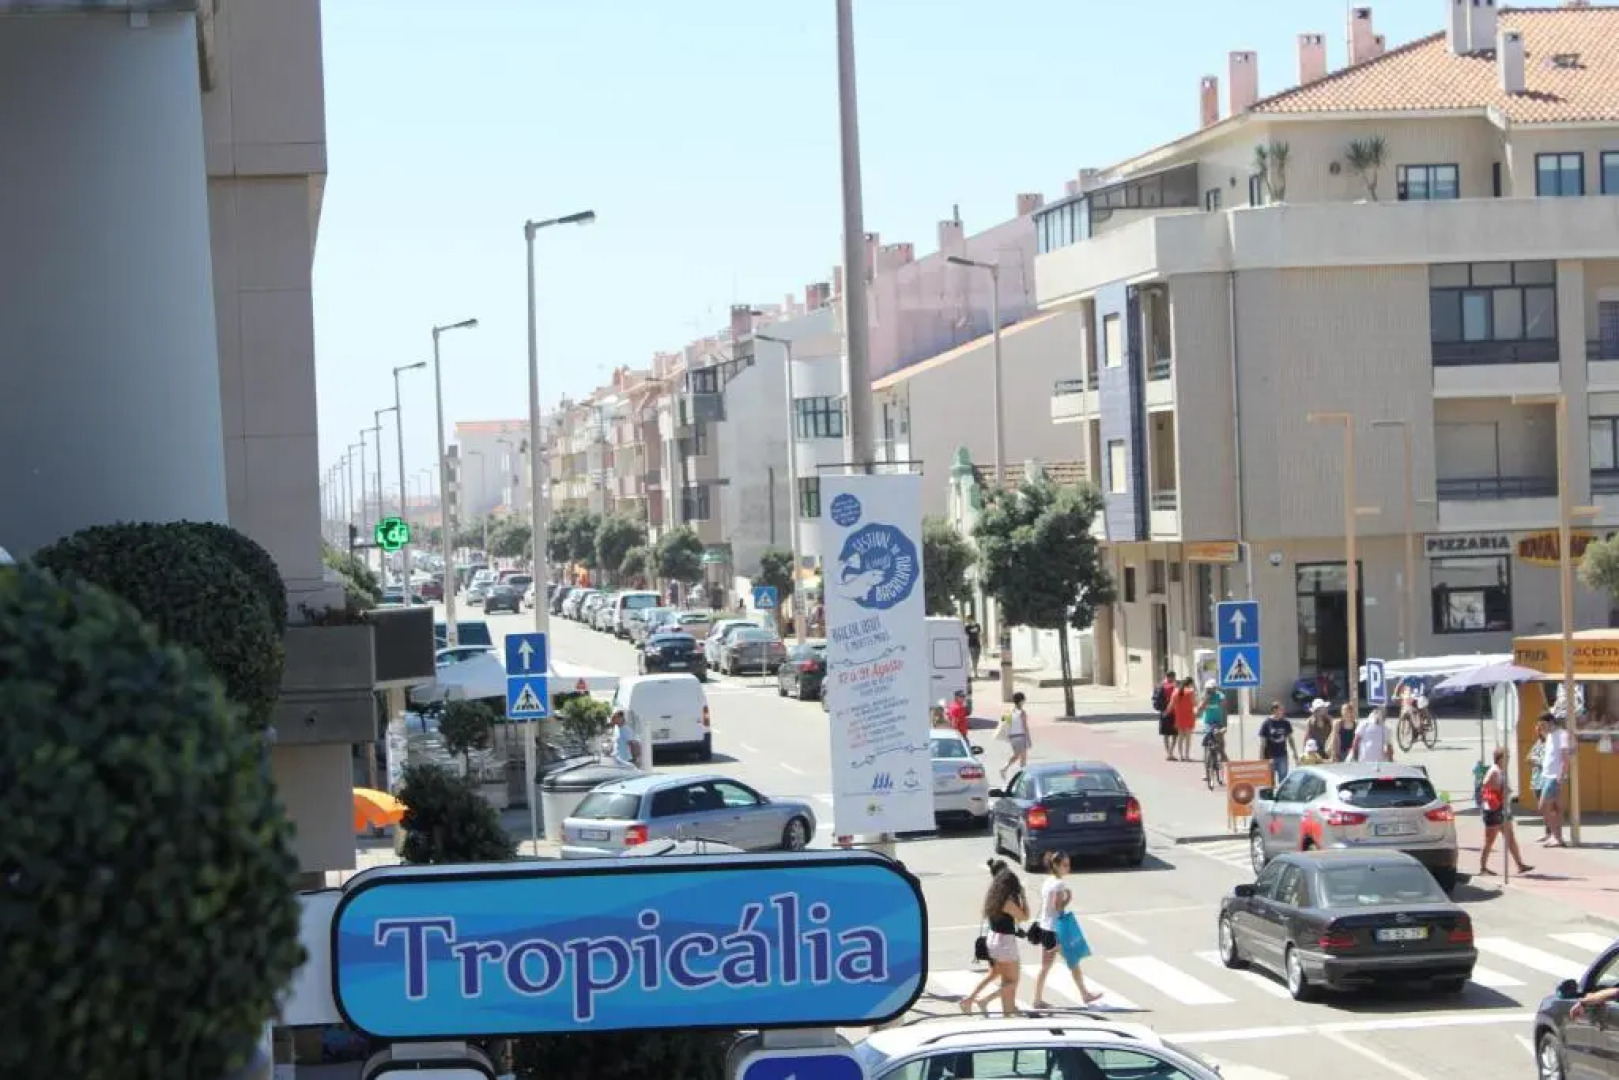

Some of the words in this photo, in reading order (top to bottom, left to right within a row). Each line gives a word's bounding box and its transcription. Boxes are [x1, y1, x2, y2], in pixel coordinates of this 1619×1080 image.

[1427, 536, 1510, 551] PIZZARIA
[1371, 667, 1382, 694] P
[374, 891, 889, 1022] Tropicália
